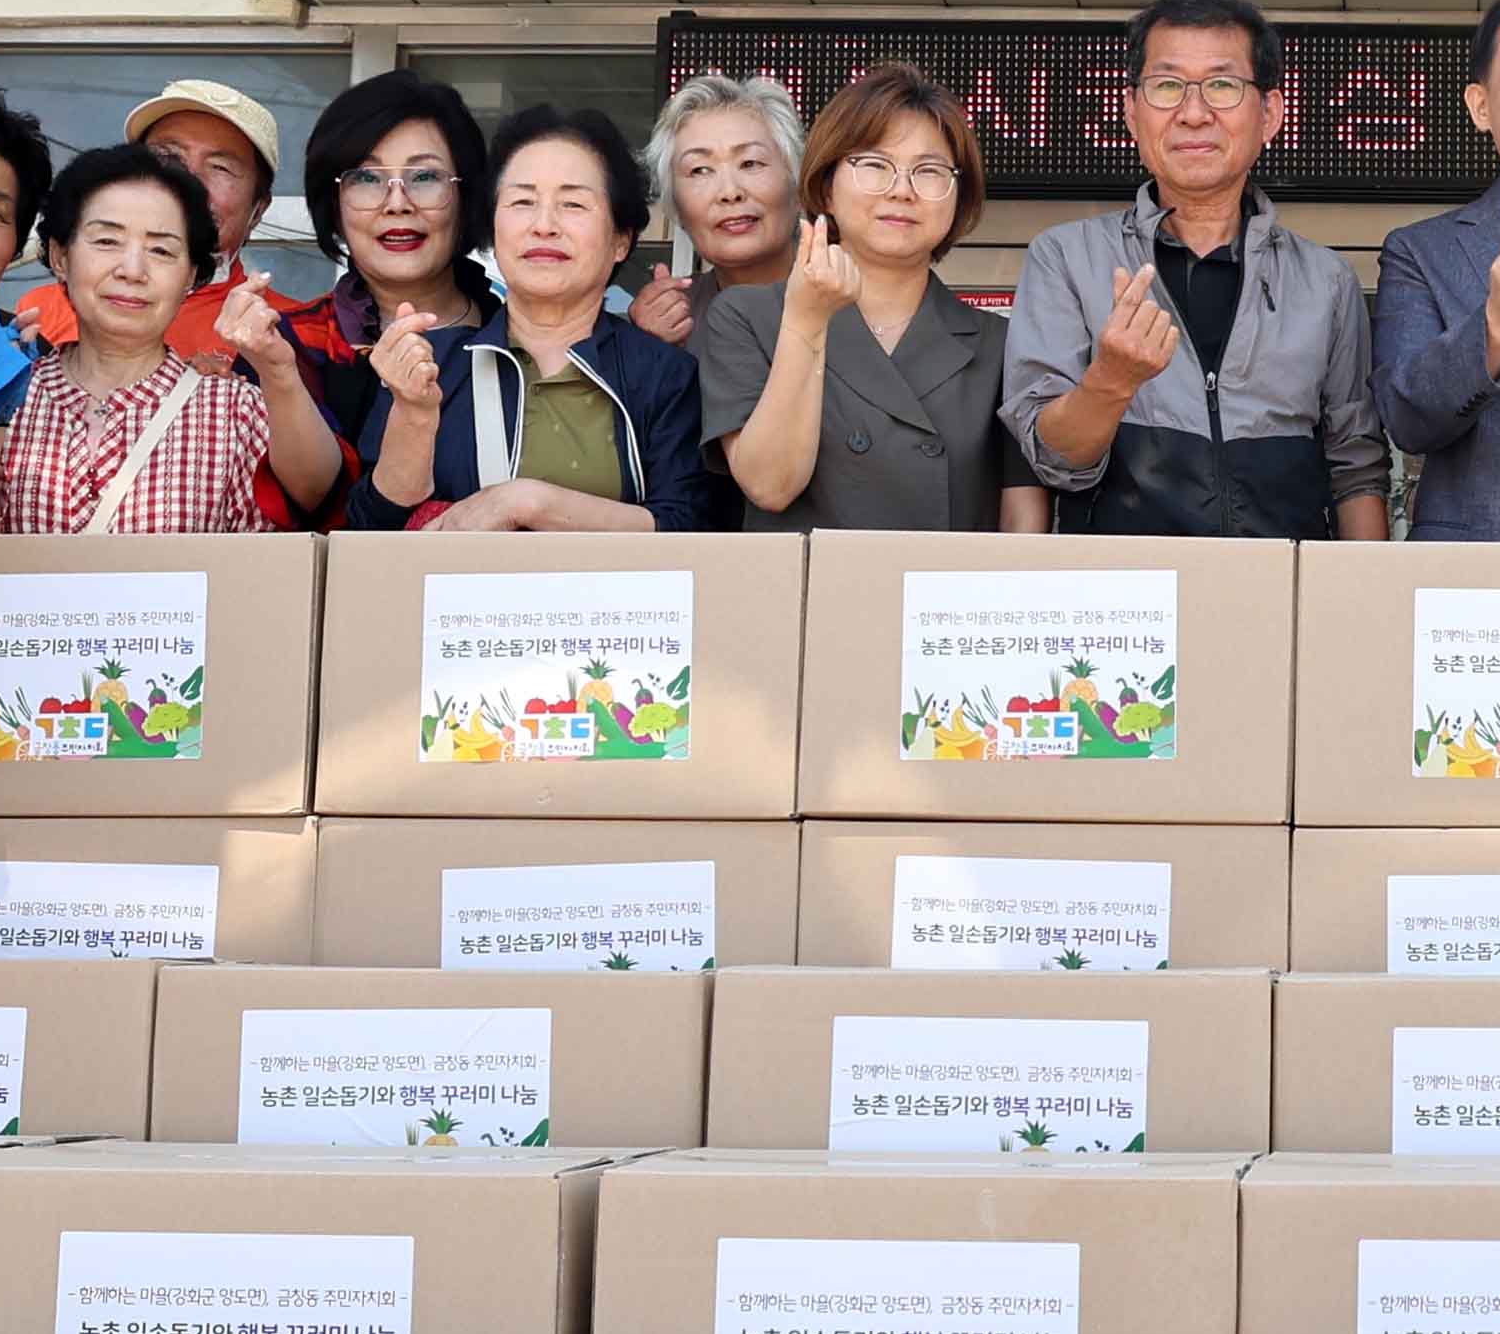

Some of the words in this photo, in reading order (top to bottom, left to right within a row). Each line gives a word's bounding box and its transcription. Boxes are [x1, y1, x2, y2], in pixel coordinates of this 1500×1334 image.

[76, 638, 108, 657] 행복
[111, 637, 159, 655] 꾸러미
[163, 637, 195, 655] 나눔
[260, 1086, 298, 1108] 농촌
[303, 1085, 394, 1108] 일손돕기와
[399, 1085, 436, 1107] 행복
[440, 1084, 496, 1106] 꾸러미
[501, 1084, 537, 1106] 나눔
[851, 1094, 890, 1116] 농촌
[895, 1095, 988, 1116] 일손돕기와
[993, 1096, 1030, 1118] 행복
[1035, 1096, 1091, 1117] 꾸러미
[1096, 1098, 1133, 1119] 나눔
[1413, 1105, 1451, 1126] 농촌
[79, 1287, 136, 1306] 함께하는
[277, 1289, 318, 1307] 금창동
[323, 1290, 395, 1307] 주민자치회
[738, 1294, 797, 1314] 함께하는
[940, 1297, 983, 1315] 금창동
[988, 1297, 1062, 1315] 주민자치회
[1380, 1296, 1439, 1315] 함께하는
